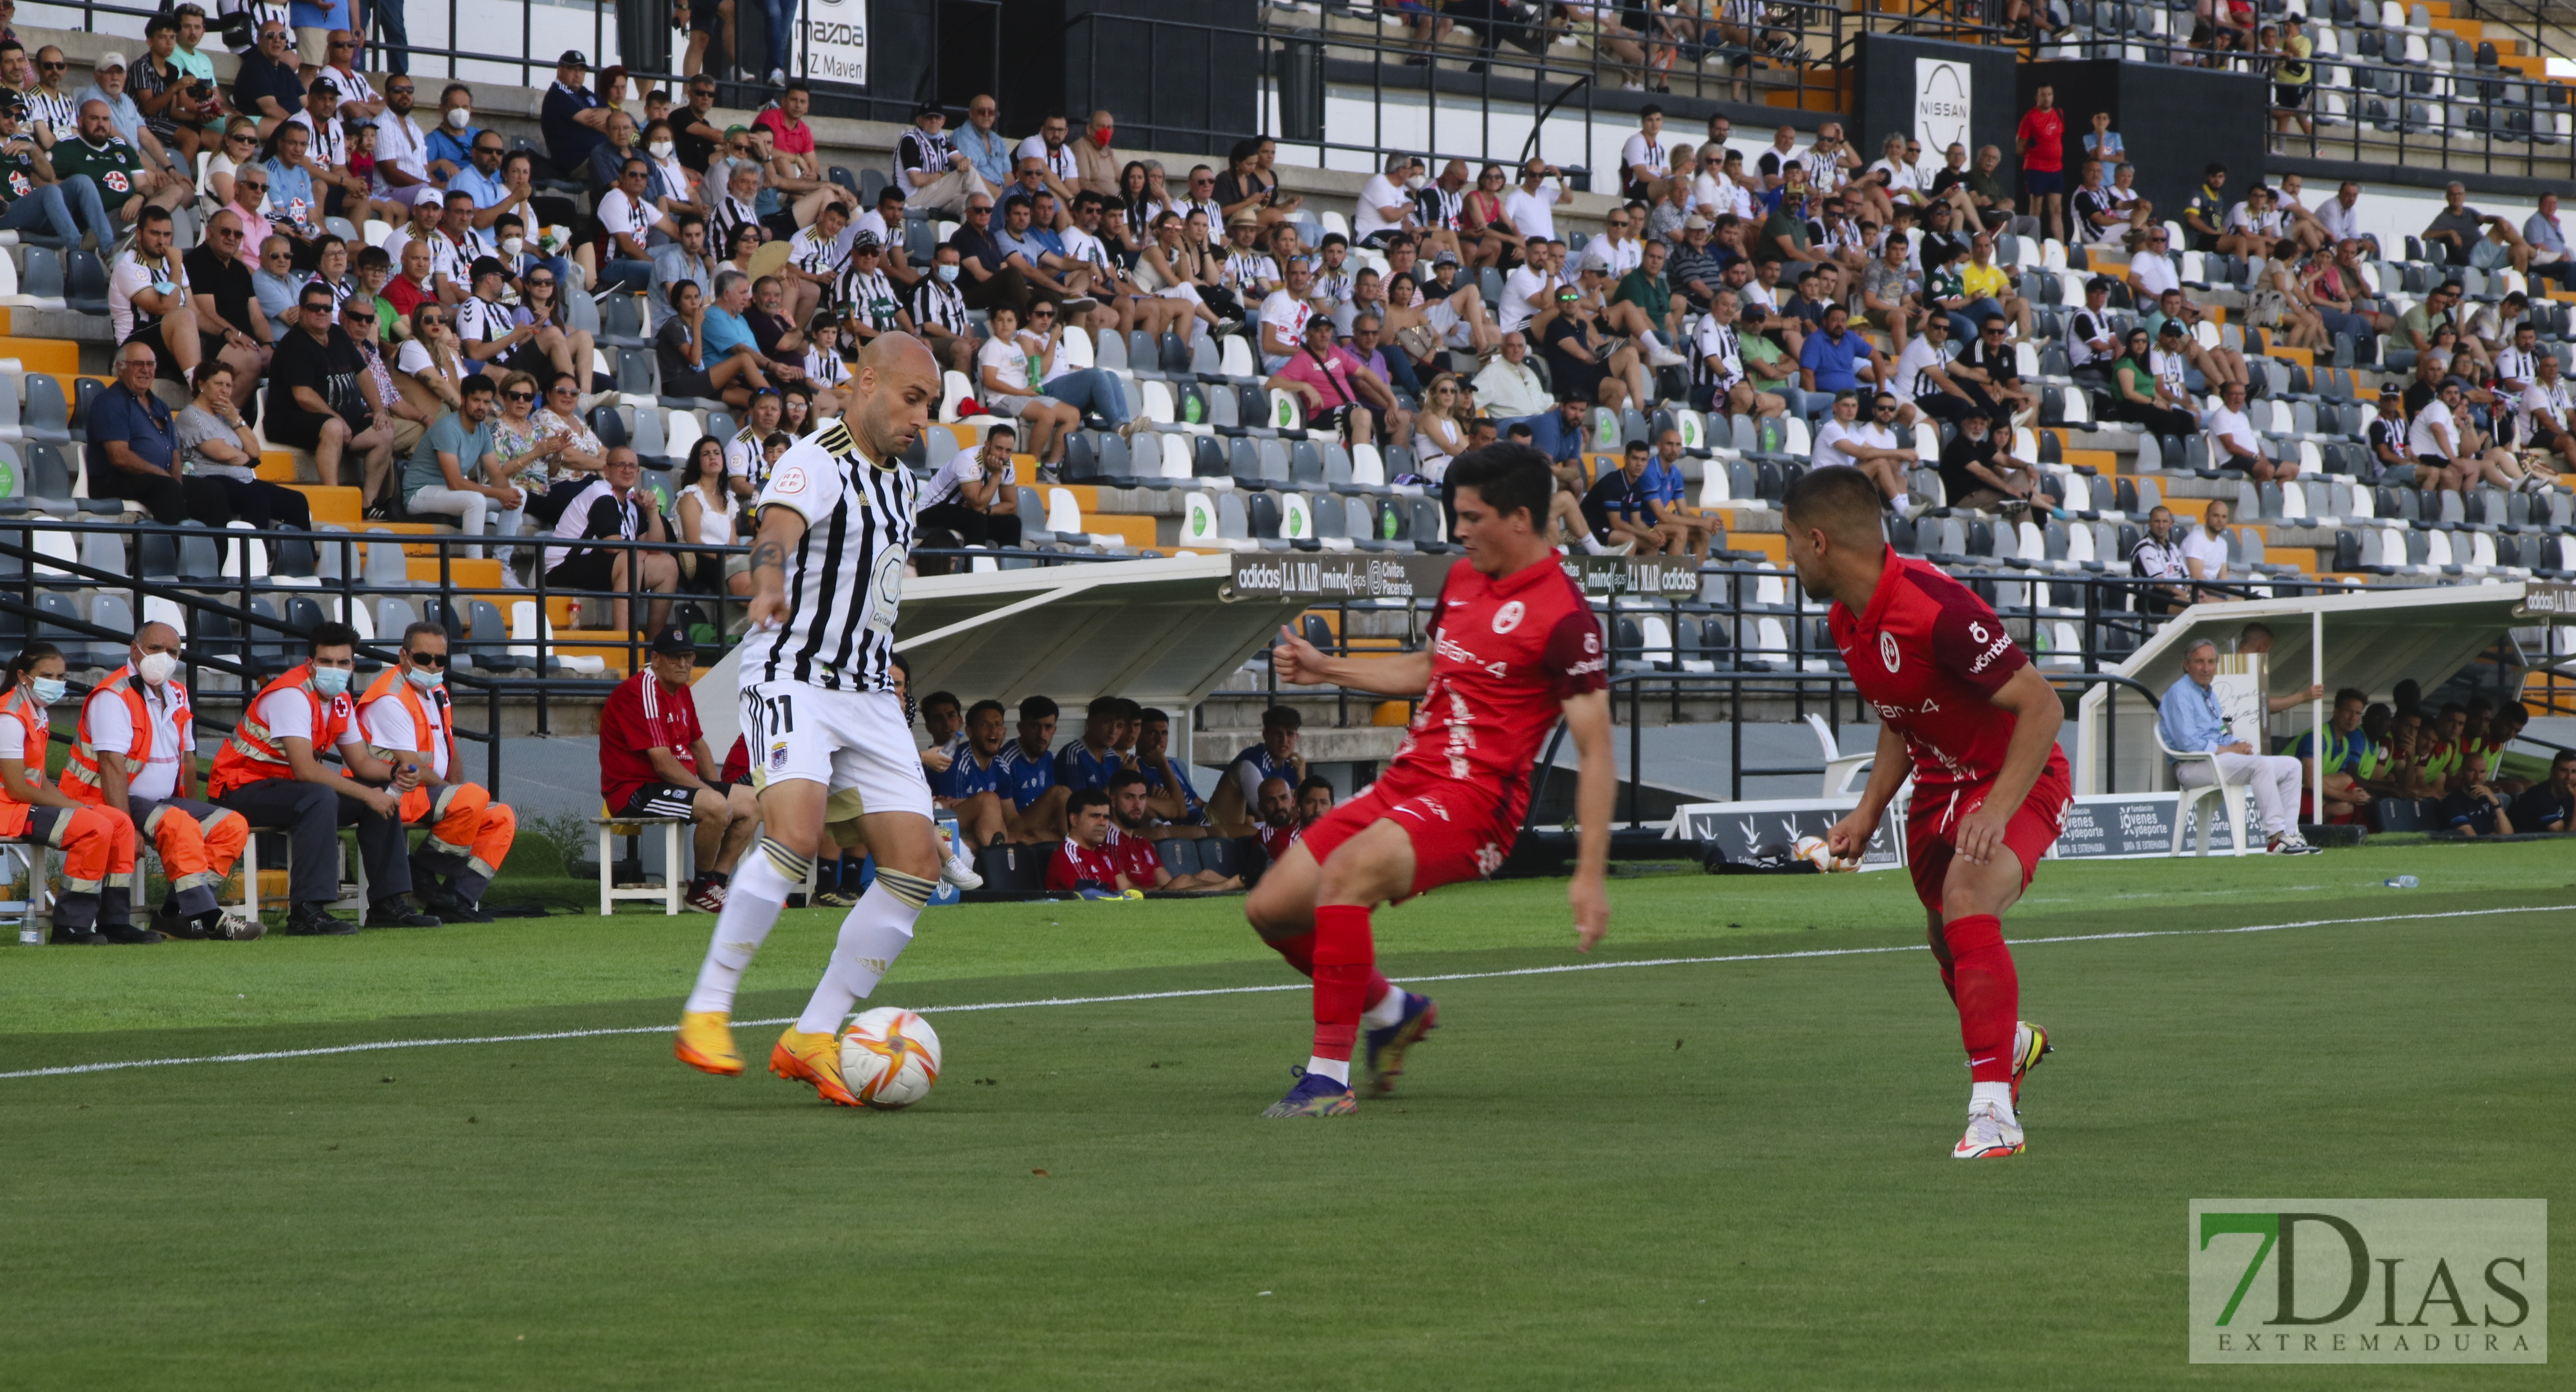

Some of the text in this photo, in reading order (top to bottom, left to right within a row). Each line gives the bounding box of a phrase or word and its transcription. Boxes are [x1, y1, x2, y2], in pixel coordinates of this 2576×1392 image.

[795, 18, 864, 48] mazda
[823, 54, 862, 79] Maven
[1920, 101, 1966, 118] NISSAN
[1239, 563, 1280, 589] adidas
[1282, 562, 1296, 591] LA
[1297, 562, 1319, 592] MAR
[1382, 561, 1404, 578] Civitas
[1626, 564, 1638, 591] LA
[1640, 564, 1659, 591] MAR
[1662, 567, 1696, 591] adidas
[1382, 579, 1413, 596] Pacensis
[2528, 591, 2554, 610] adidas
[2554, 590, 2564, 612] LA
[873, 612, 891, 627] Civitas
[766, 694, 793, 737] 11
[2067, 816, 2094, 828] venes
[2070, 827, 2104, 841] ydeporte
[2133, 824, 2168, 838] ydeporte
[2078, 843, 2106, 853] EXTREMADURA
[2142, 840, 2170, 850] EXTREMADURA
